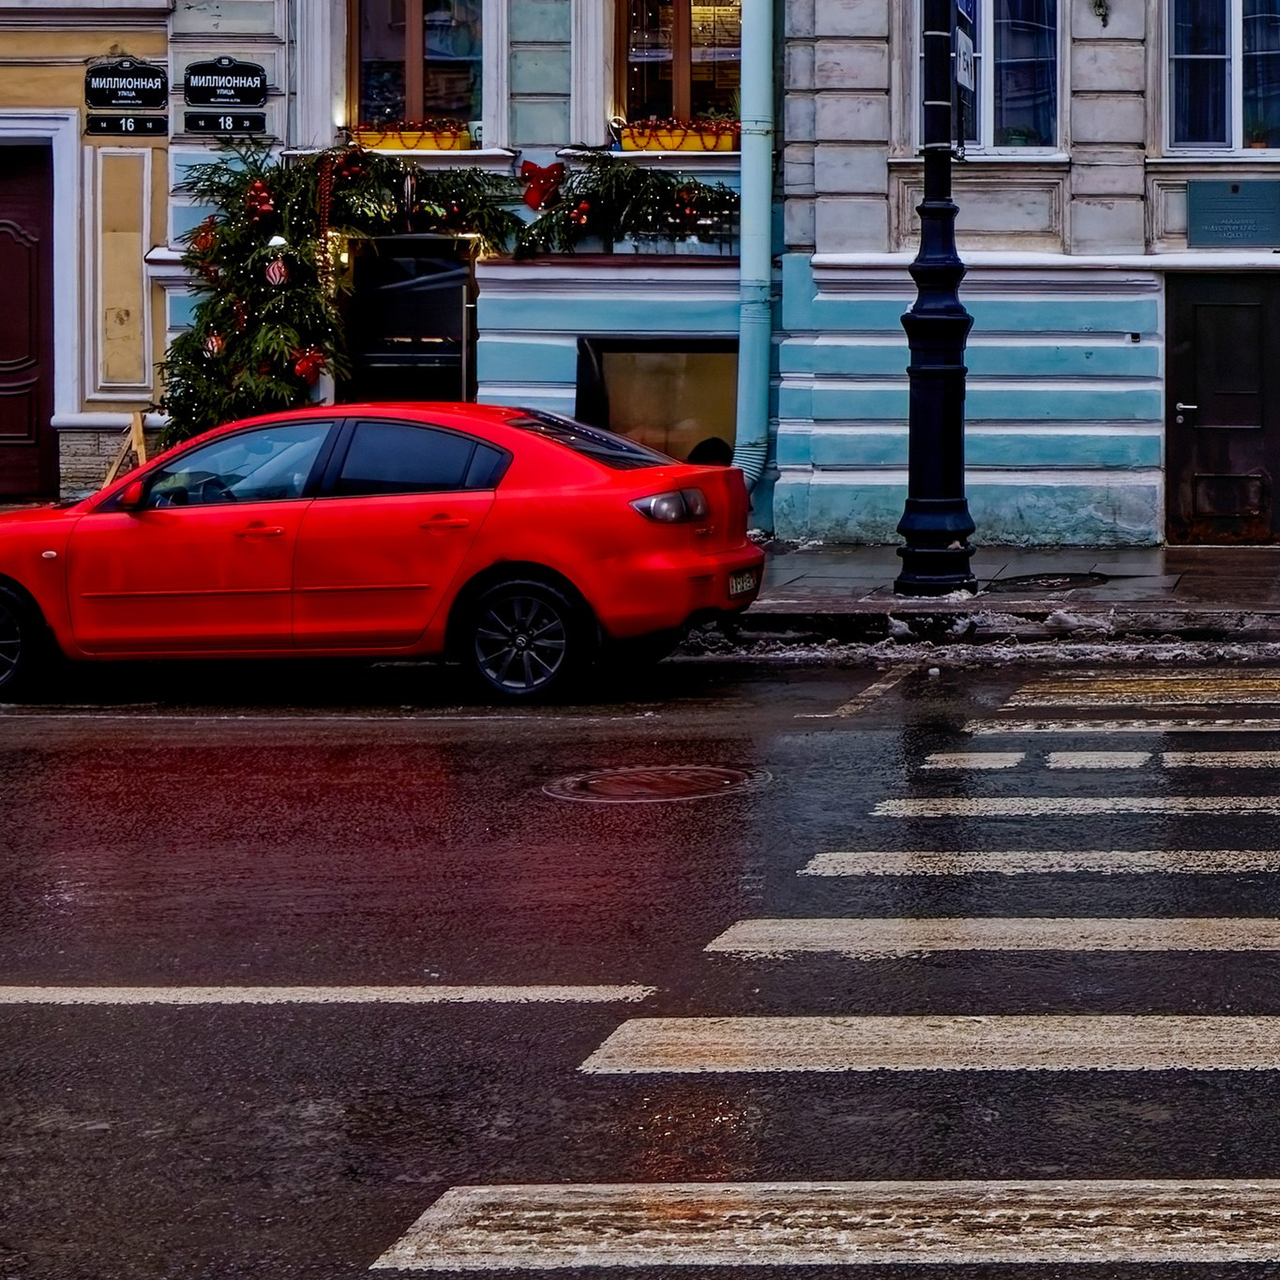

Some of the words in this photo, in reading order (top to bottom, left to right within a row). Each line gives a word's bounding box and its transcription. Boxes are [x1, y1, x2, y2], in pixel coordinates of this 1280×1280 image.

[91, 77, 162, 90] МИЛЛИОННАЯ
[190, 75, 261, 88] МИЛЛИОННАЯ
[216, 88, 235, 96] УЛИЦА
[119, 117, 135, 131] 16
[218, 116, 233, 130] 18
